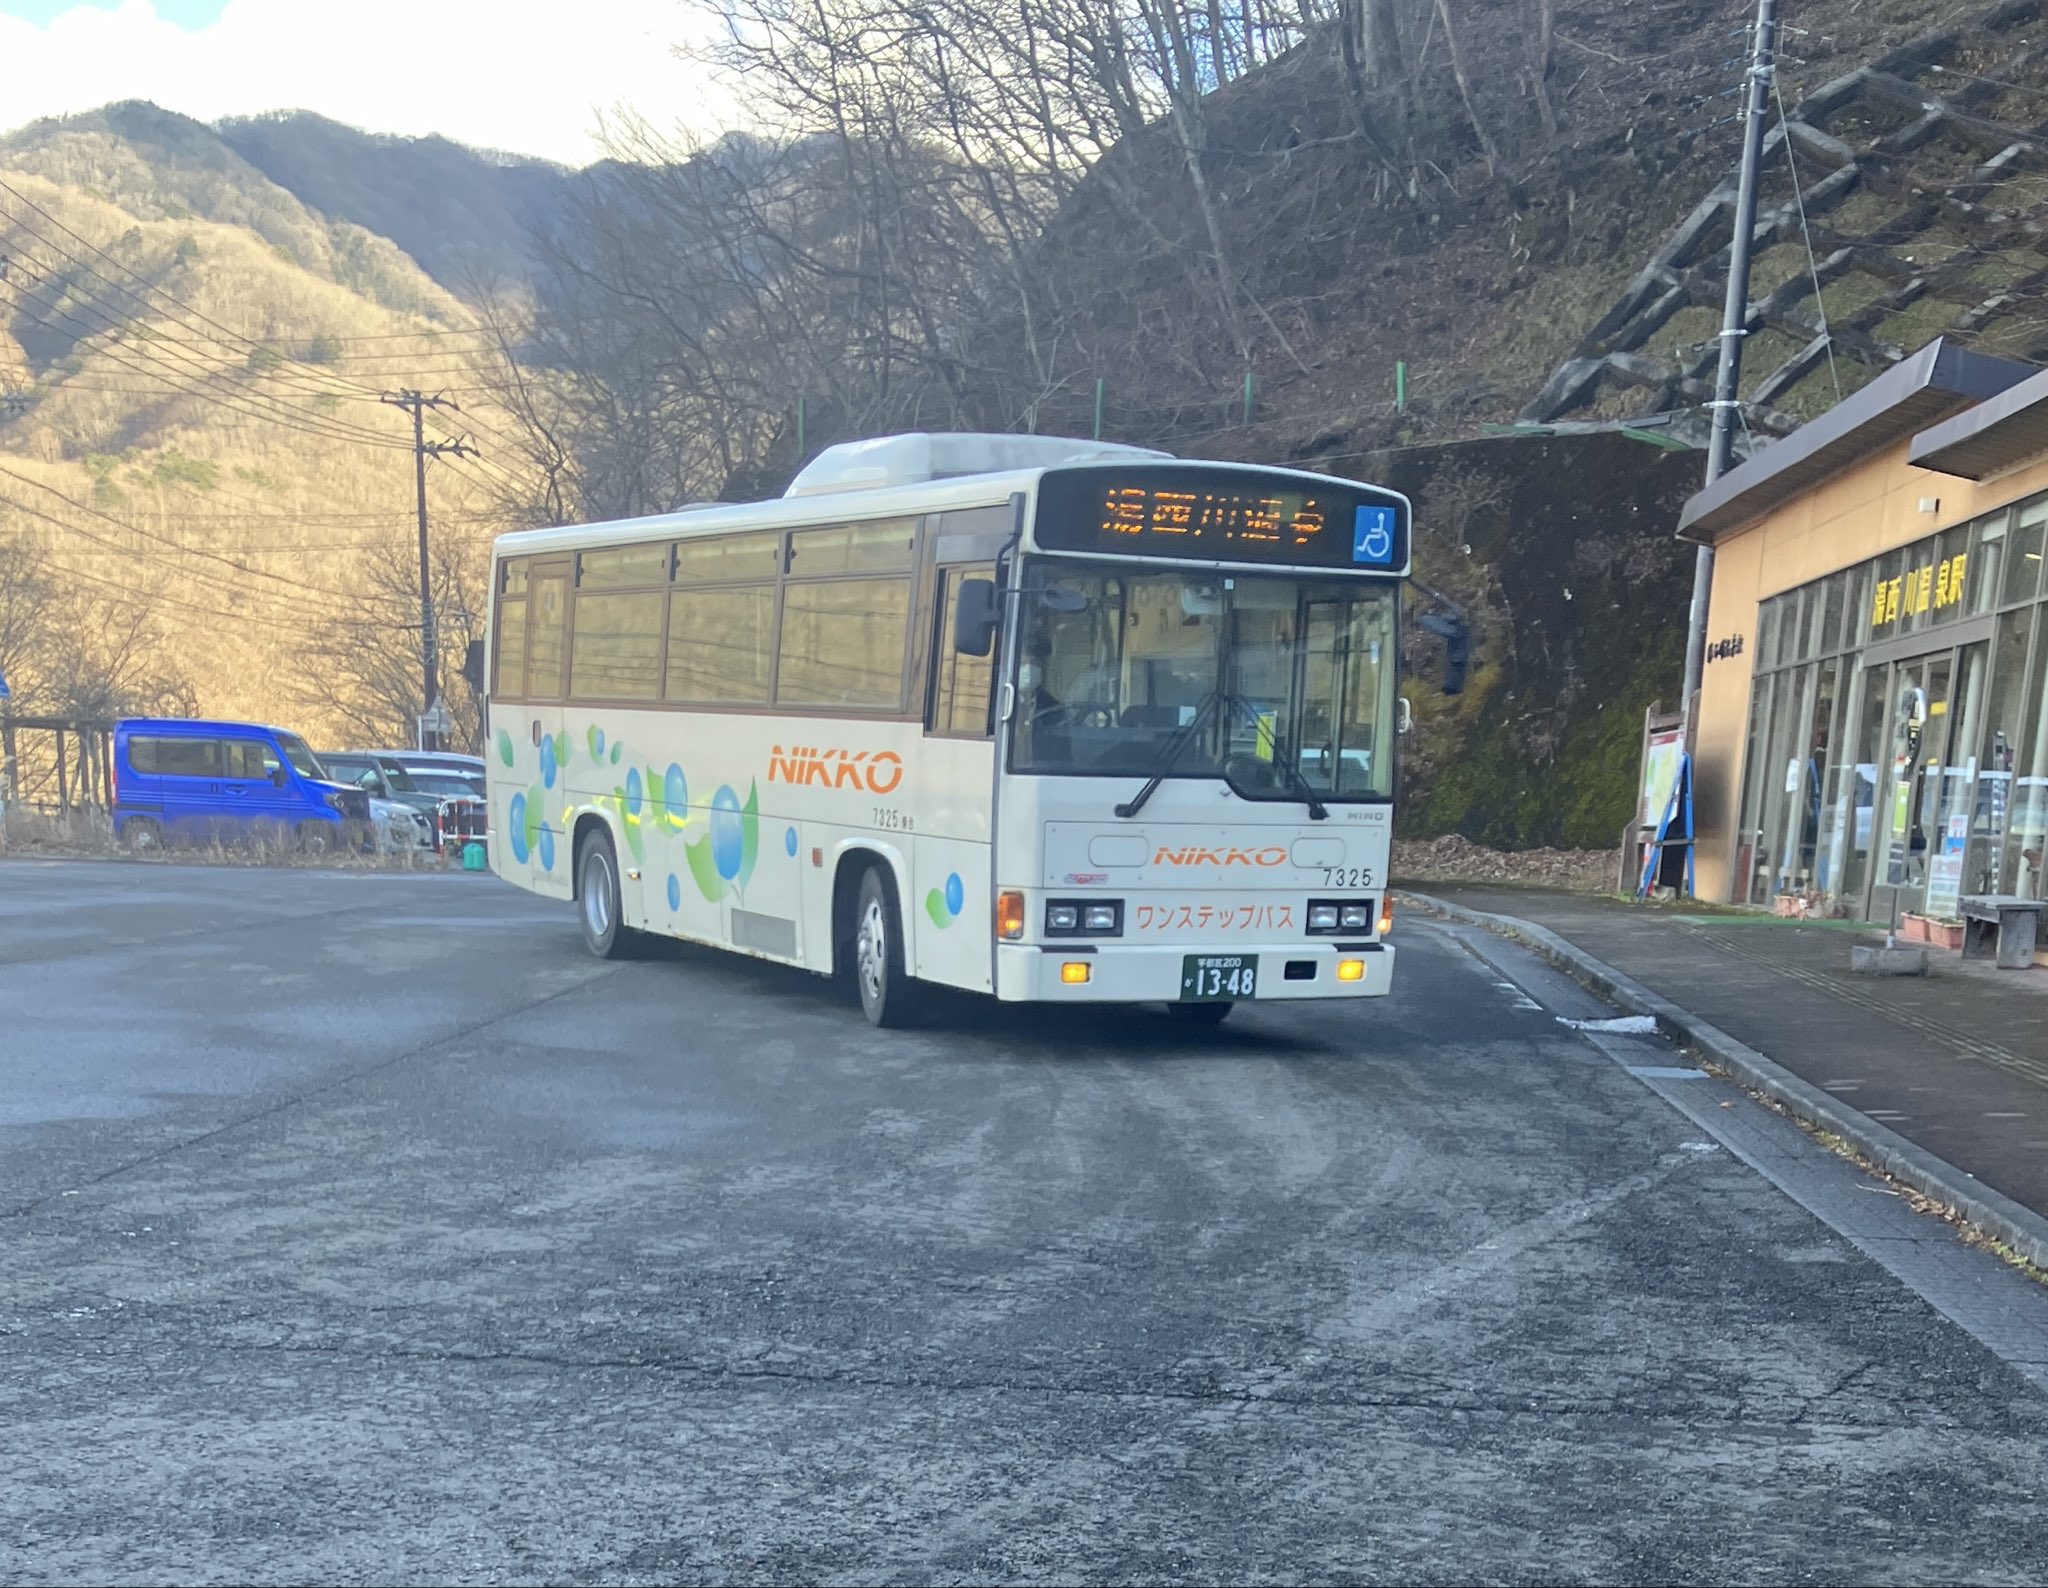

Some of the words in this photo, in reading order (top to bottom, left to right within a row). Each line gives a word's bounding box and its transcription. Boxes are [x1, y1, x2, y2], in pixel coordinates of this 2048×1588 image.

[1872, 553, 1967, 626] 湯西川温泉駅
[767, 744, 904, 794] NIKKO
[872, 807, 898, 828] 7325
[1347, 811, 1384, 821] HINO
[1153, 846, 1287, 867] NIKKO
[1323, 868, 1372, 887] 7325
[1136, 905, 1294, 929] ワンステップバス
[1196, 968, 1254, 996] 13-48
